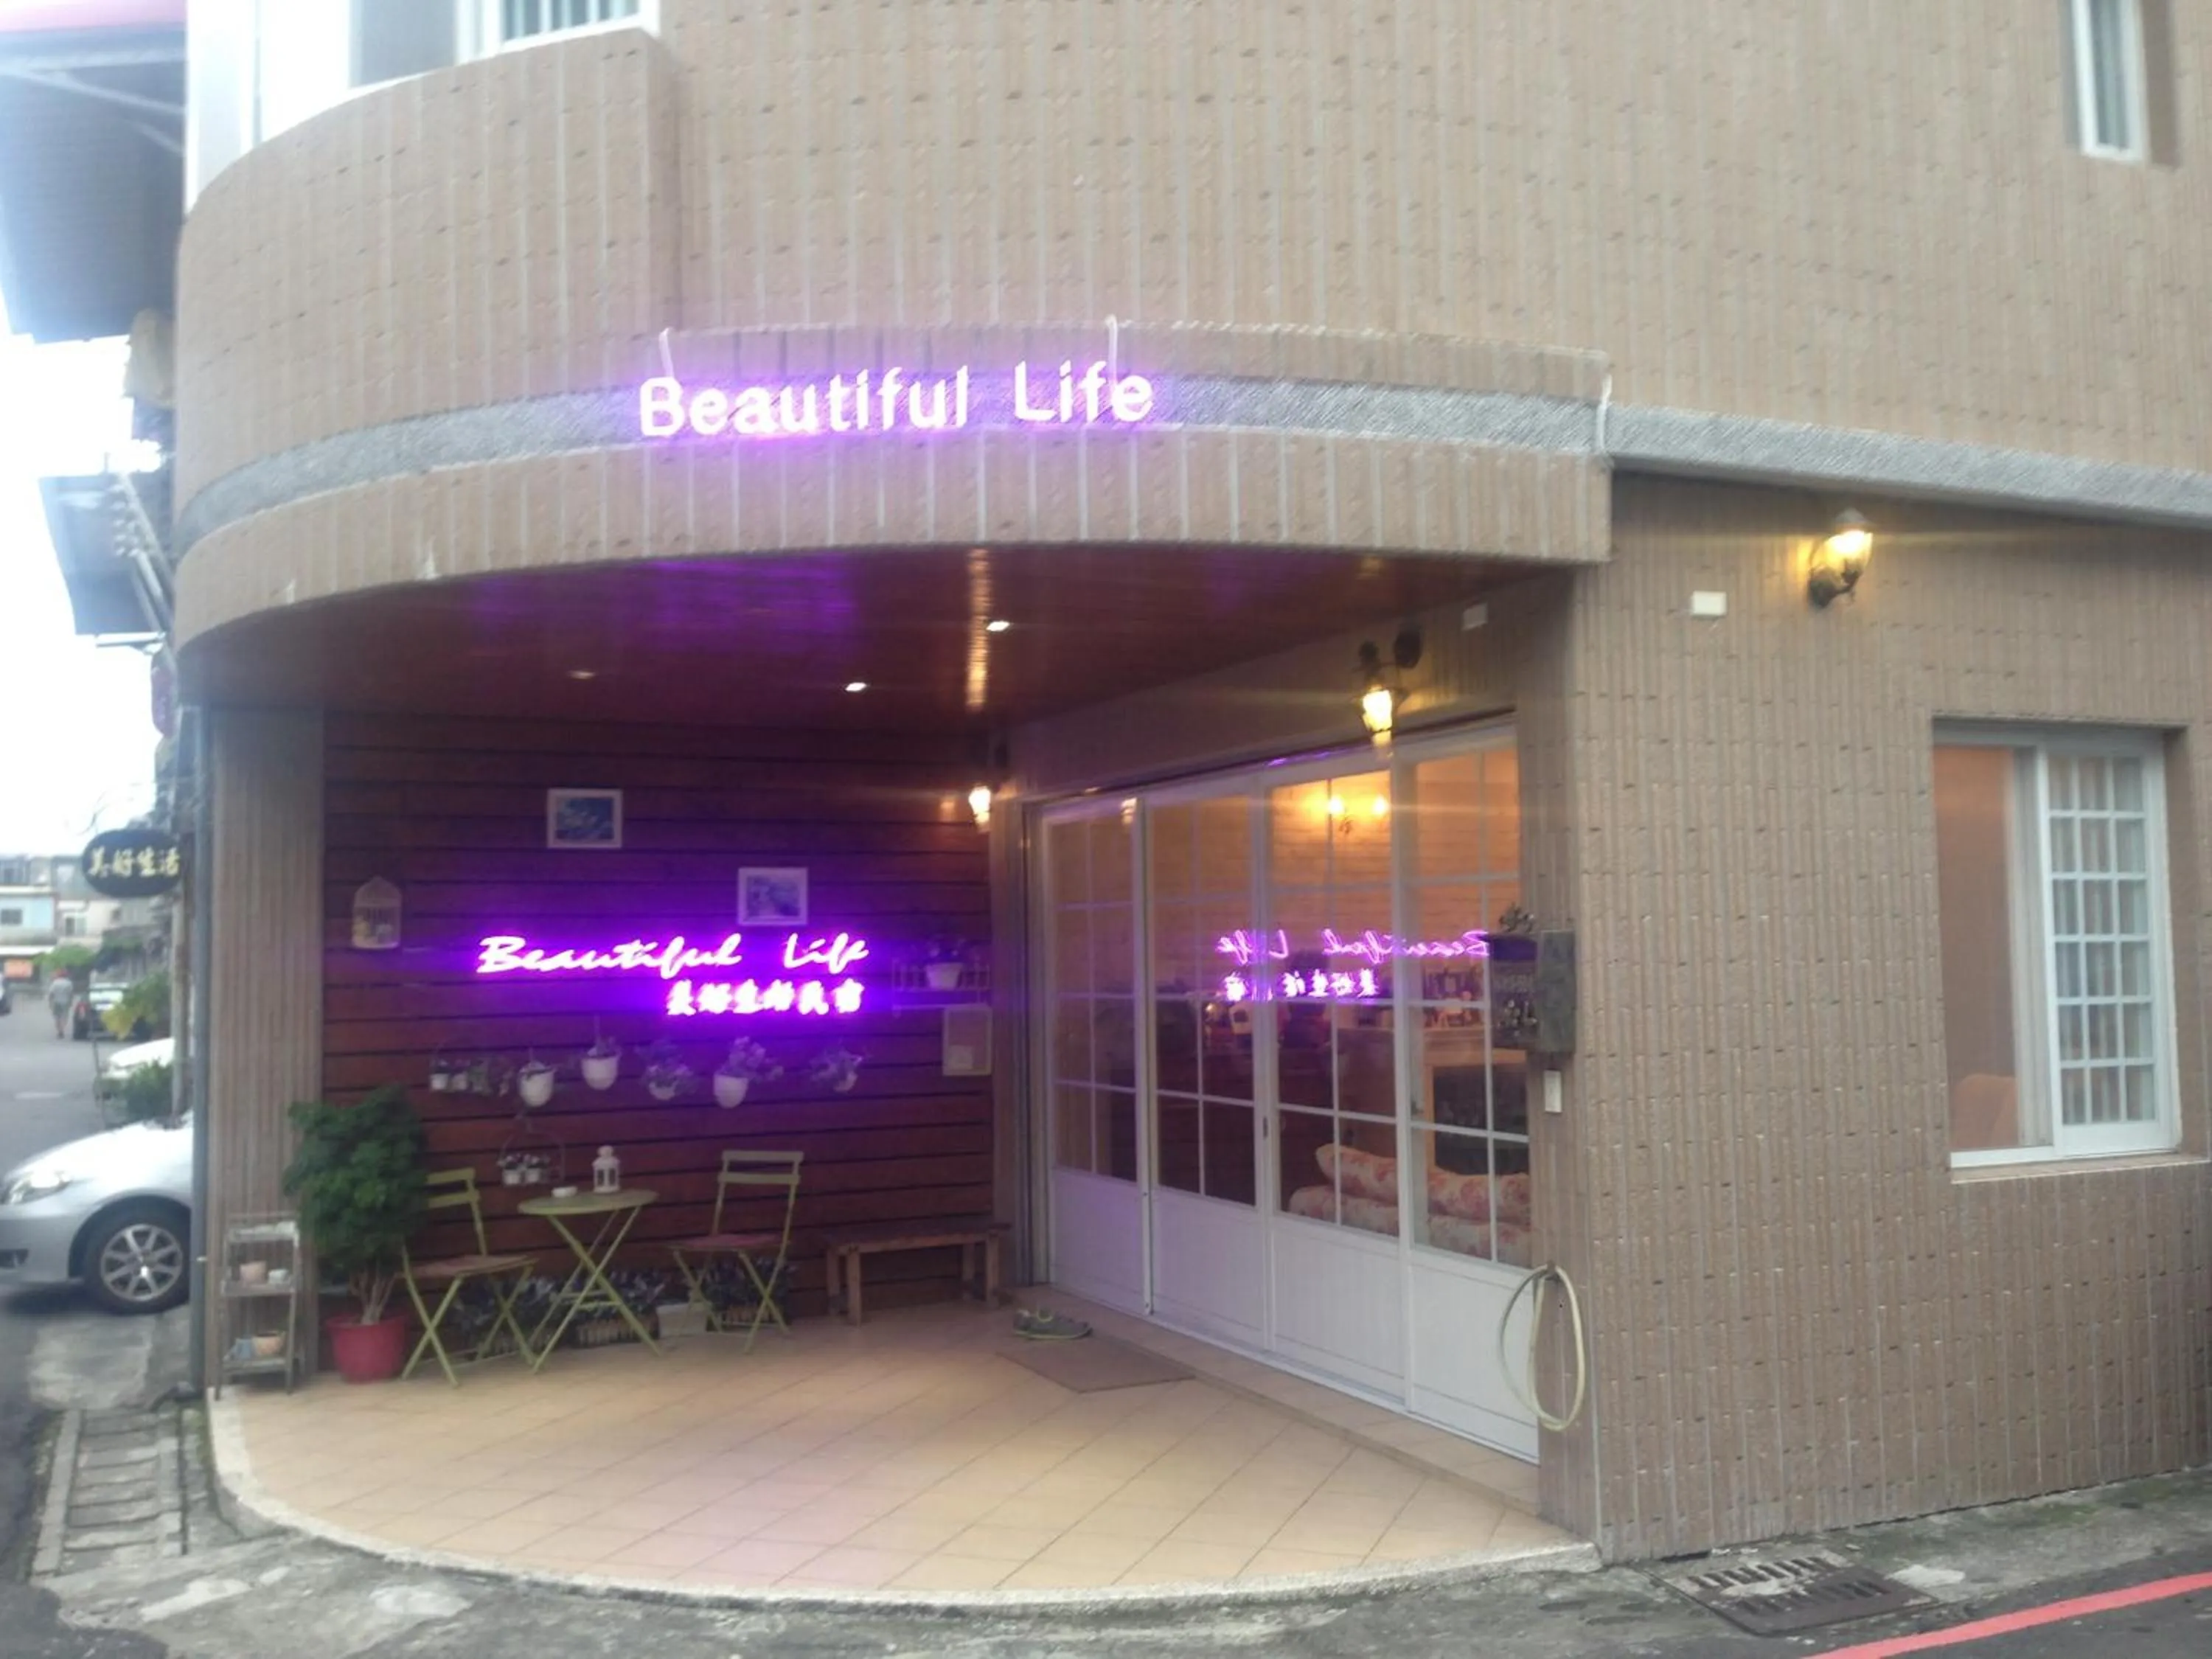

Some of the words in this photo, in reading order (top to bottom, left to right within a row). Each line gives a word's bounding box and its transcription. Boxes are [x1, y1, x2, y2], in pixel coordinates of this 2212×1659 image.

[639, 364, 969, 437] Beautiful
[1014, 359, 1155, 423] Life
[87, 846, 181, 877] 美好生活
[476, 933, 742, 979] Beautiful
[782, 932, 870, 974] Life
